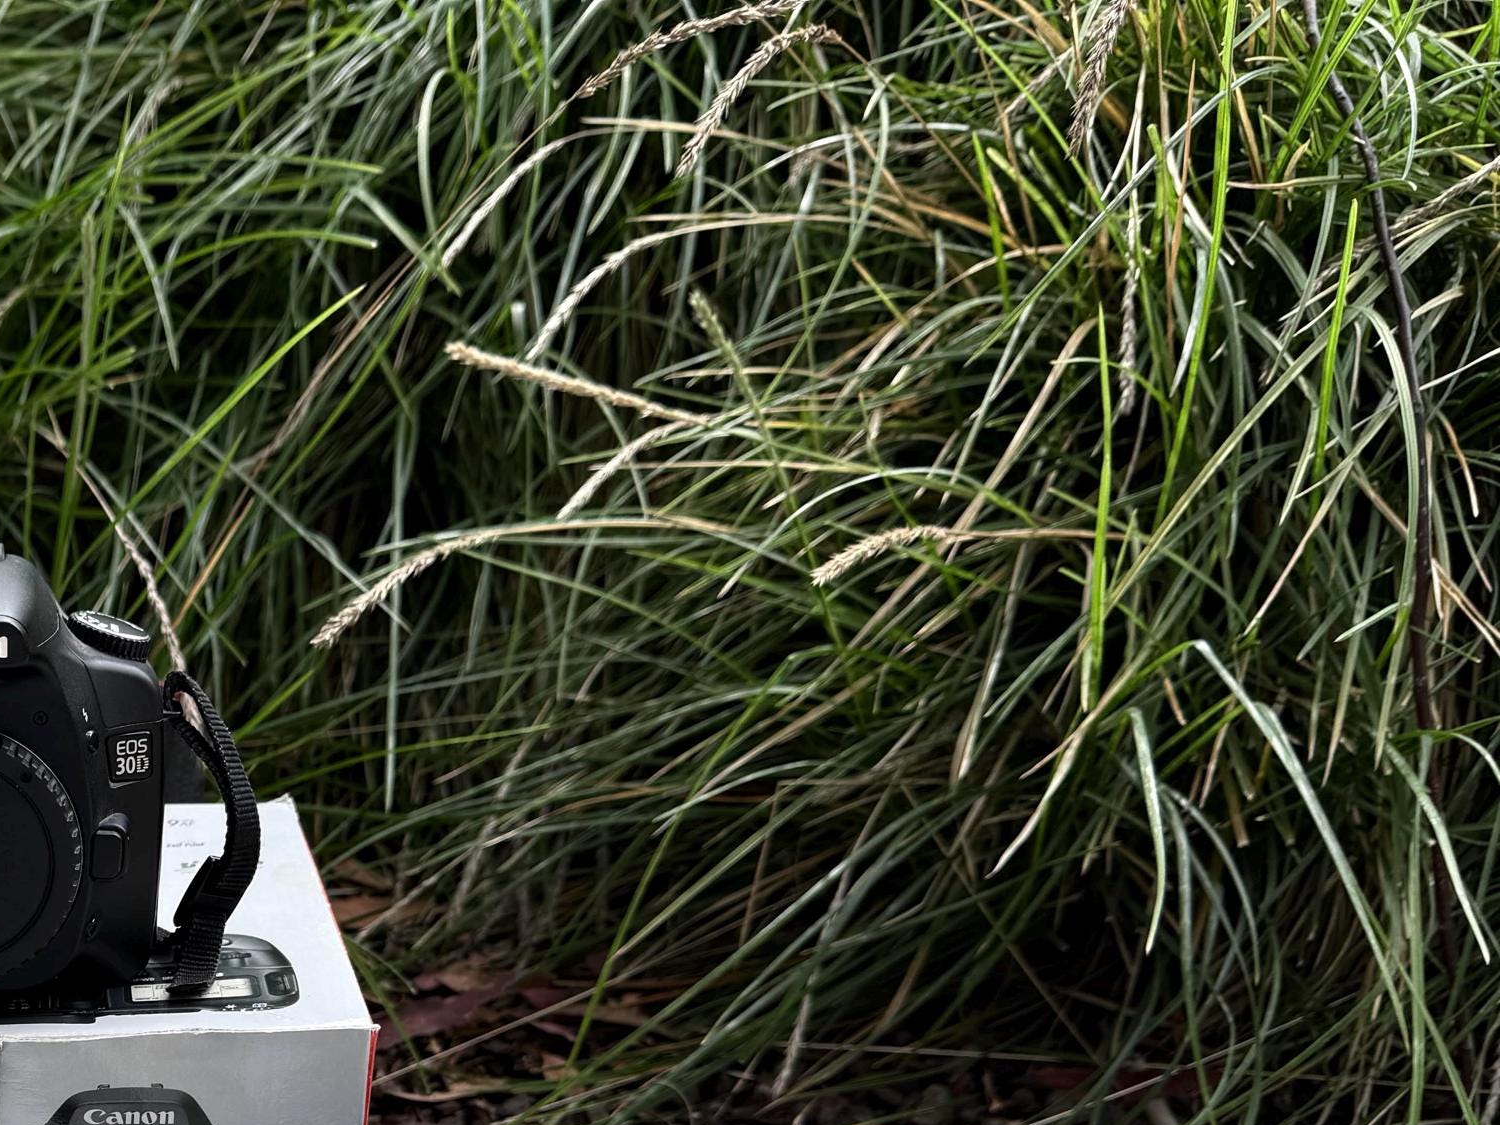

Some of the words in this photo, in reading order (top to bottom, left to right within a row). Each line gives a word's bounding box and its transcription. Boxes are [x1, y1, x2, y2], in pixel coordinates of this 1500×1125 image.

[116, 738, 147, 754] EOS
[115, 756, 149, 775] 30D
[83, 1108, 175, 1125] Canon
